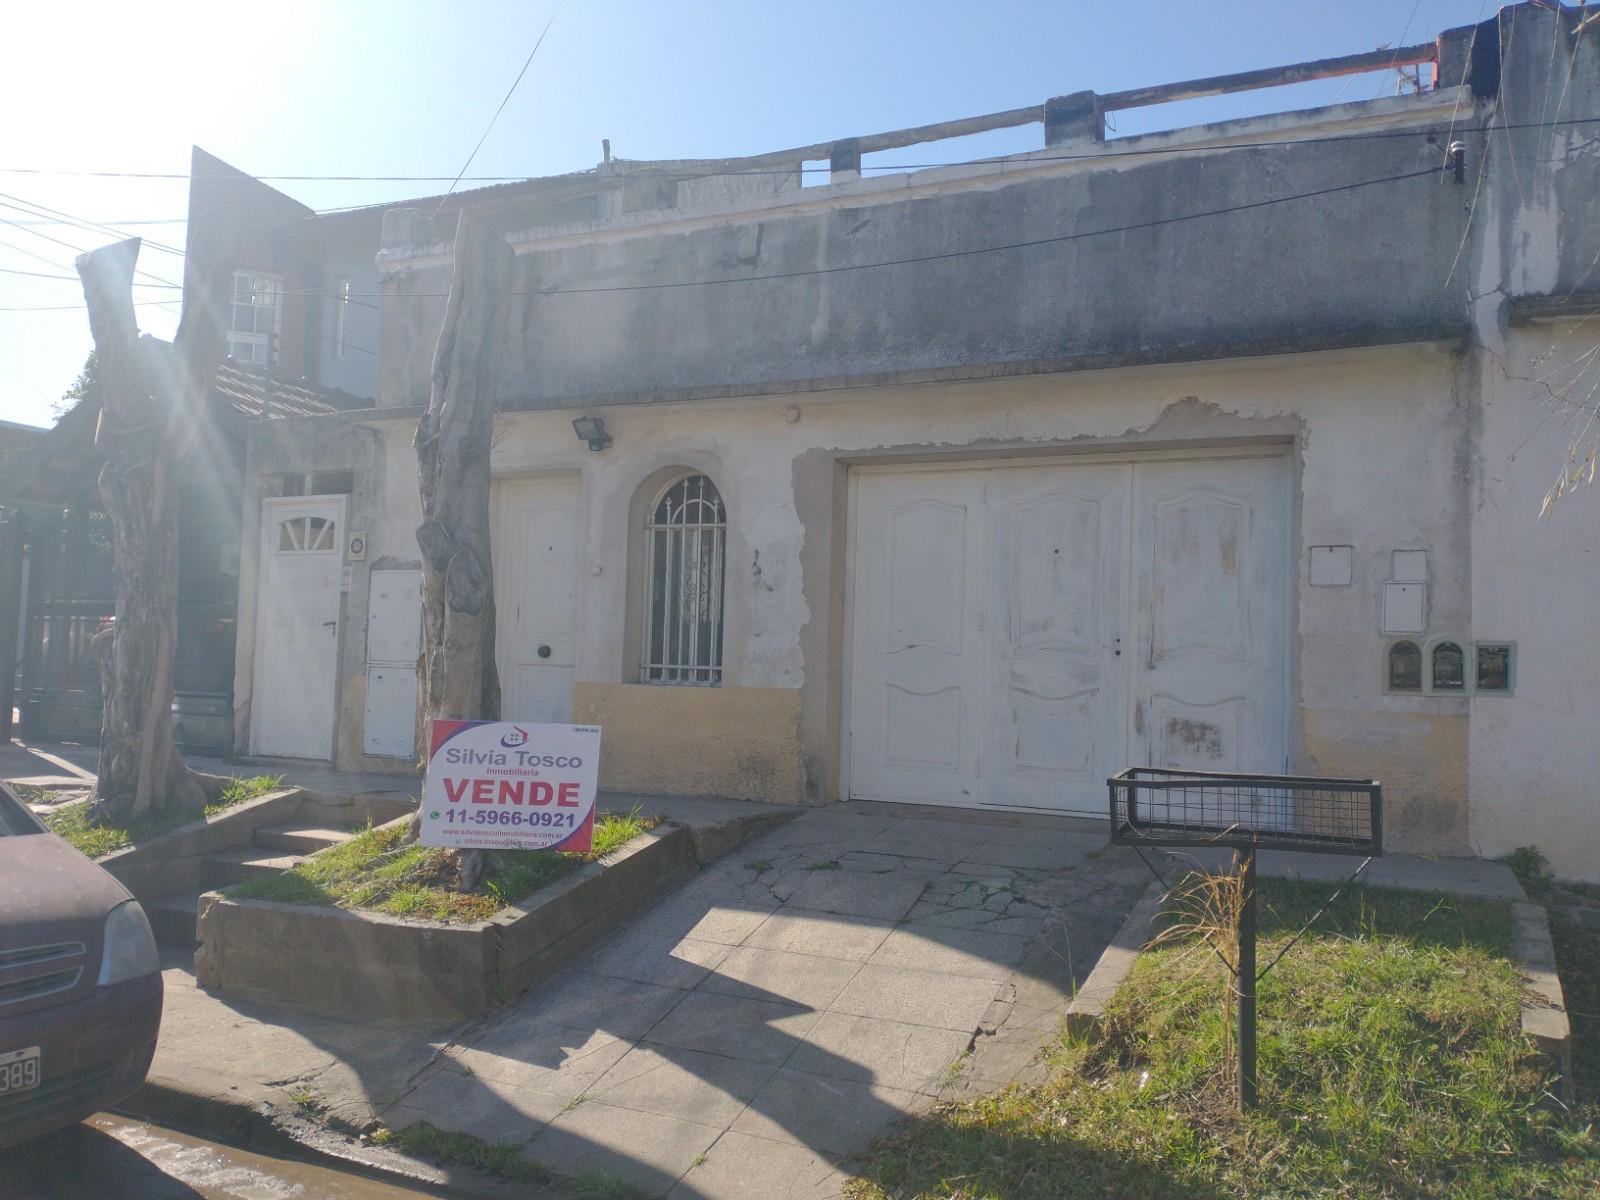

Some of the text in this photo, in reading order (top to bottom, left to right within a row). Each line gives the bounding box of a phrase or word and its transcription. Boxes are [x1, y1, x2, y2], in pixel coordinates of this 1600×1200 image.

[445, 748, 583, 768] Silvia Tosco
[443, 778, 580, 807] VENDE
[445, 808, 575, 828] 11-5966-0921
